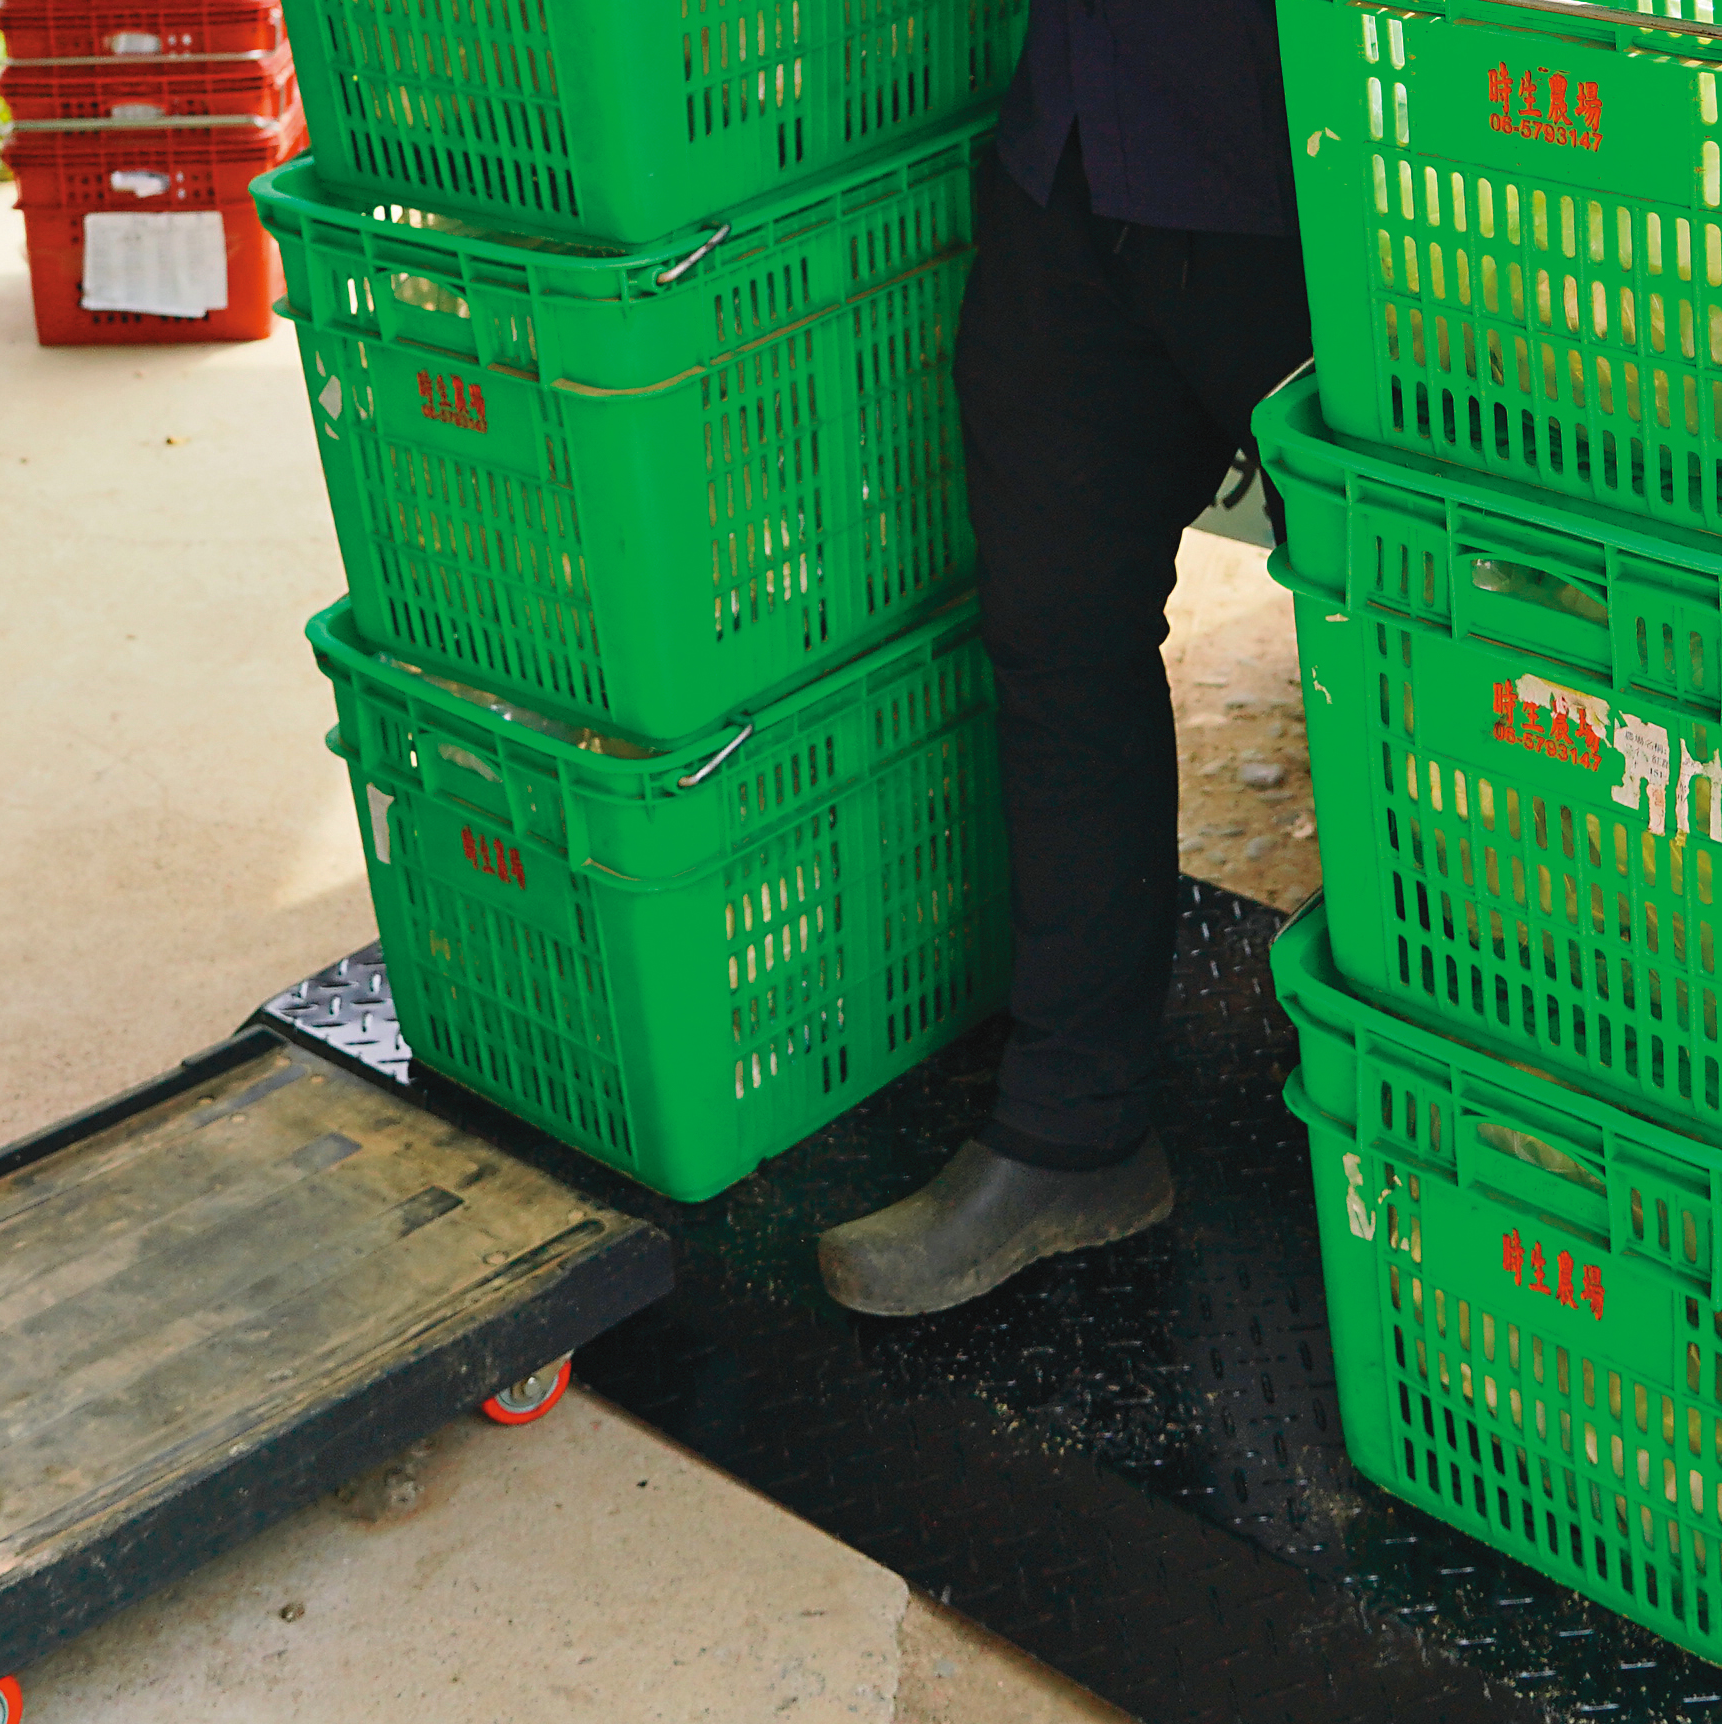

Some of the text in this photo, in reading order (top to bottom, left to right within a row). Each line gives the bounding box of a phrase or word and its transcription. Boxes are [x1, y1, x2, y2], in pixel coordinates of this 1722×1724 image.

[1488, 61, 1603, 132] 時生農場
[1489, 112, 1603, 153] 06-5793147
[1492, 722, 1603, 772] 06-5793147
